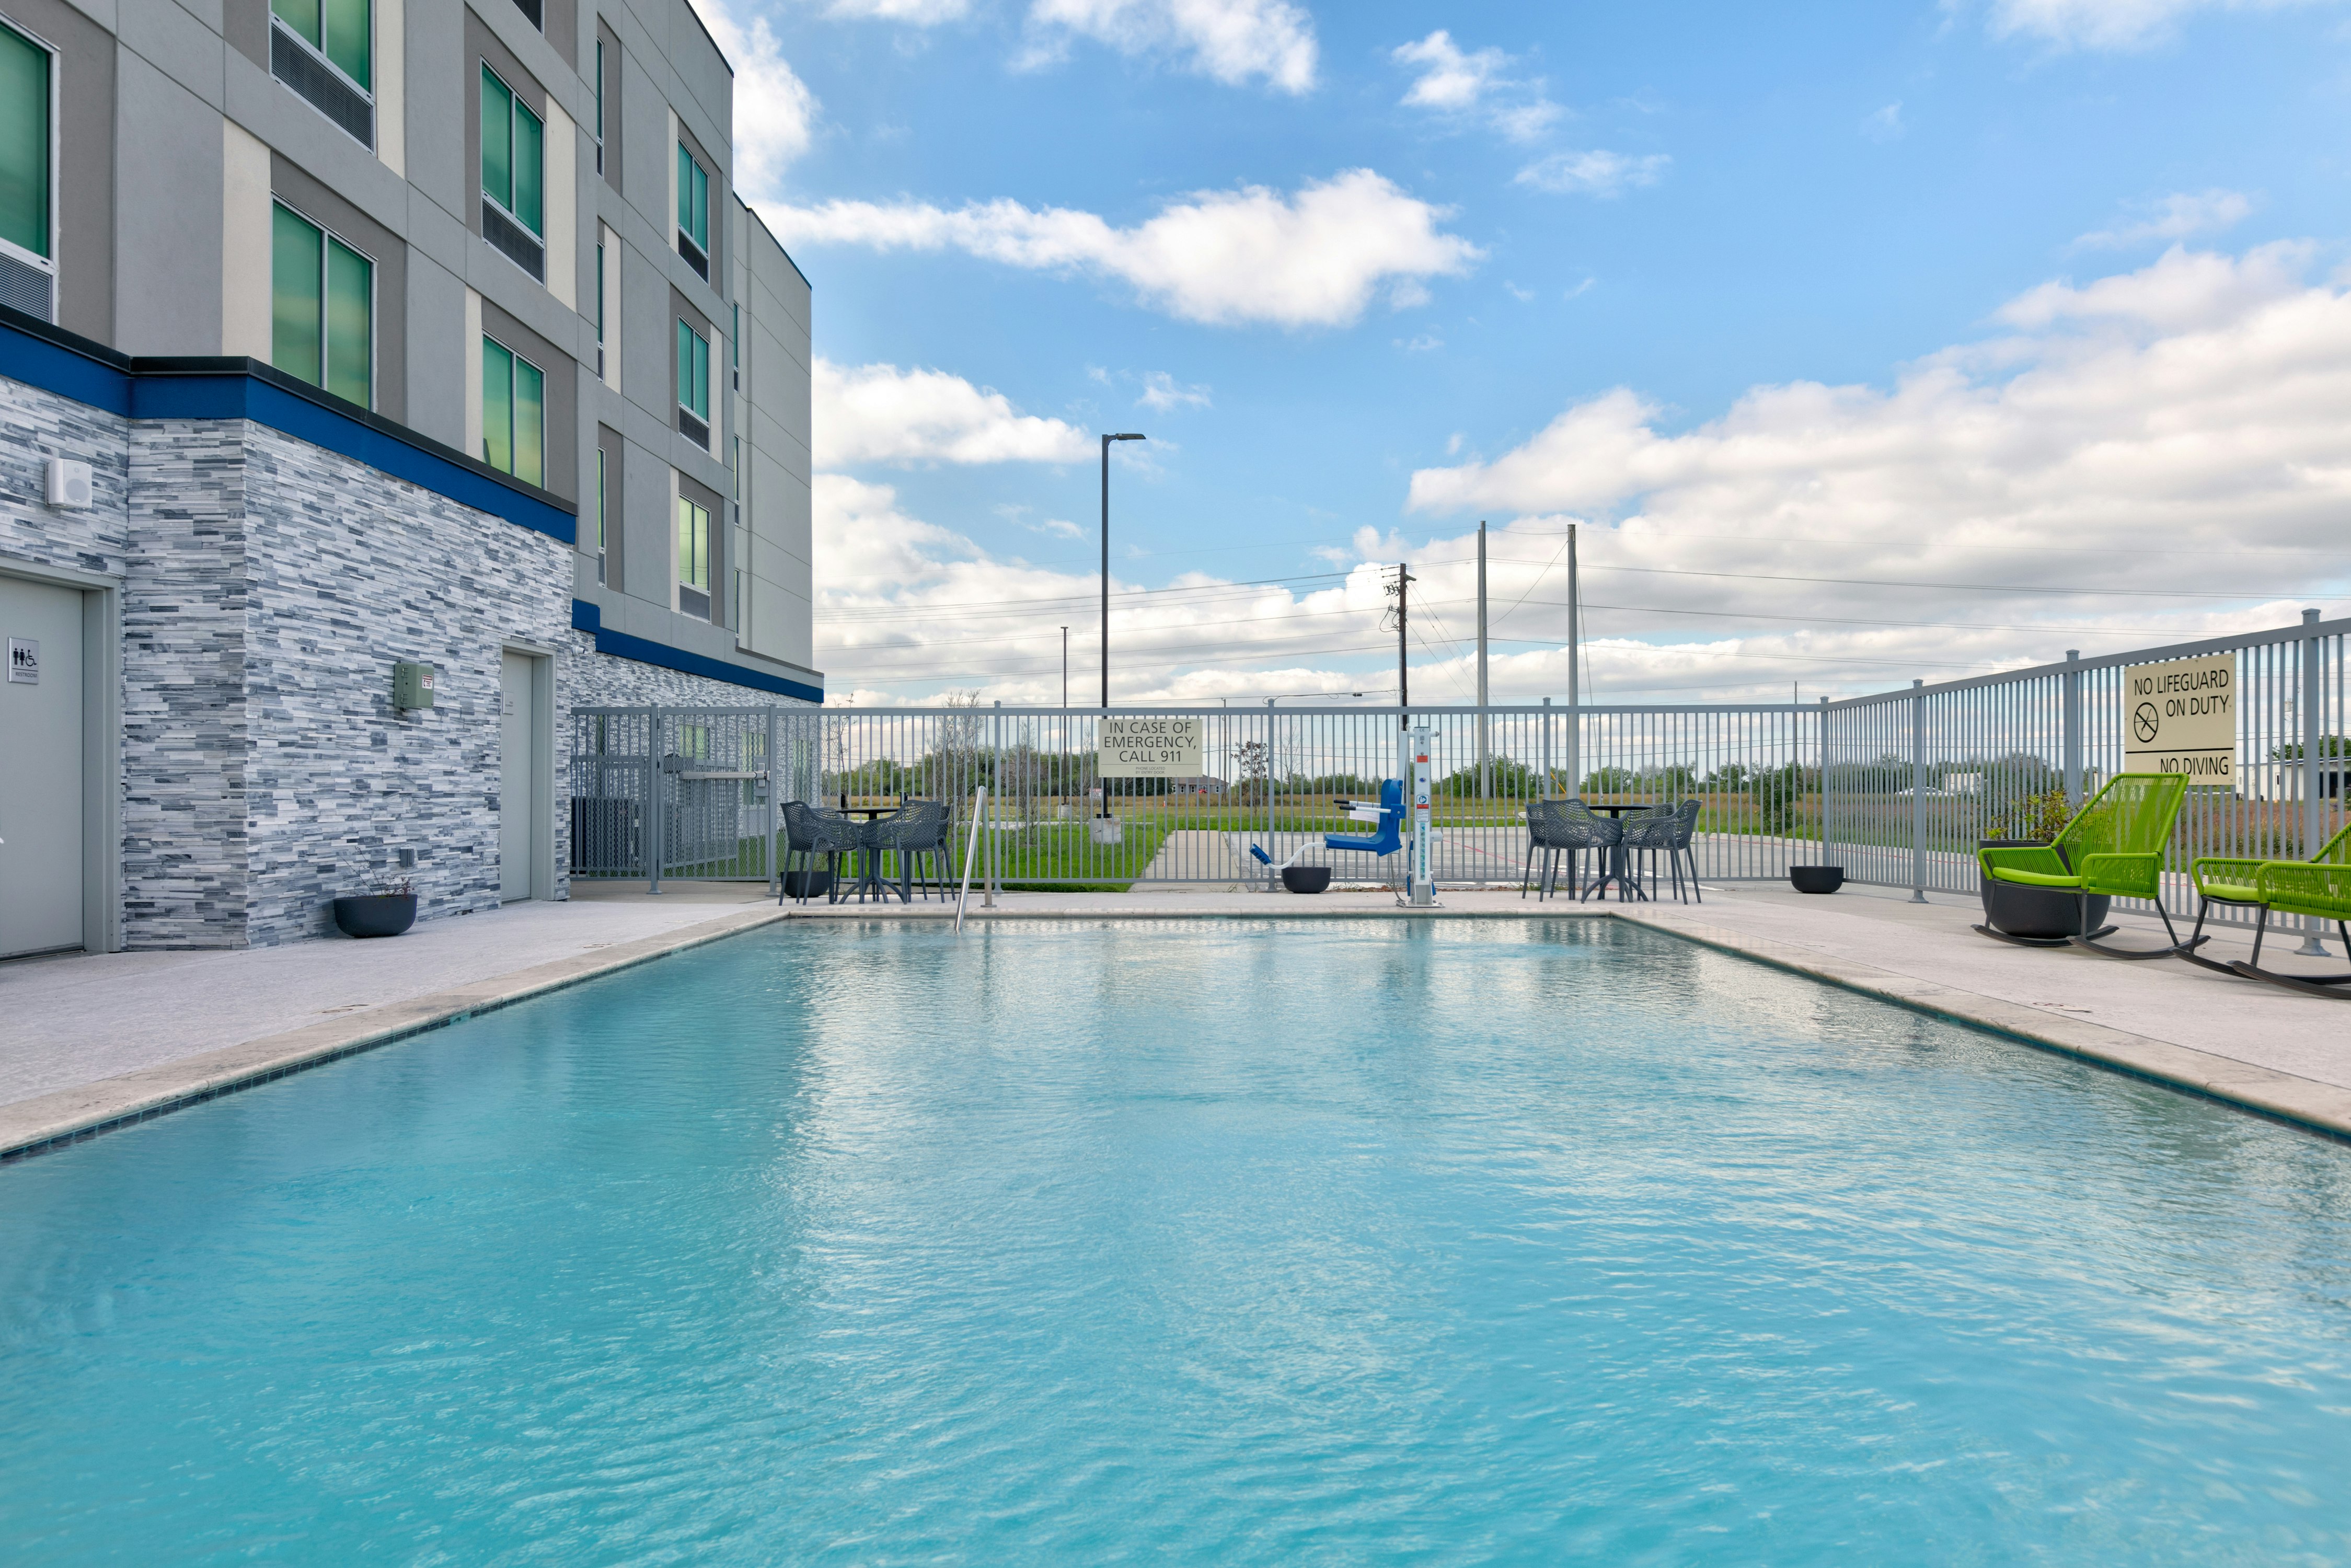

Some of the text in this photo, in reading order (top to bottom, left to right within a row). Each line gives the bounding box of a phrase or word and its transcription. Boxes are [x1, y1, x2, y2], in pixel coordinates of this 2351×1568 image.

[2134, 669, 2229, 696] NO LIFEGUARD
[2166, 695, 2229, 717] ON DUTY
[1110, 722, 1191, 733] IN CASE OF
[1104, 736, 1196, 750] EMERGENCY,
[1119, 751, 1181, 762] CALL 911
[2160, 756, 2229, 775] NO DIVING
